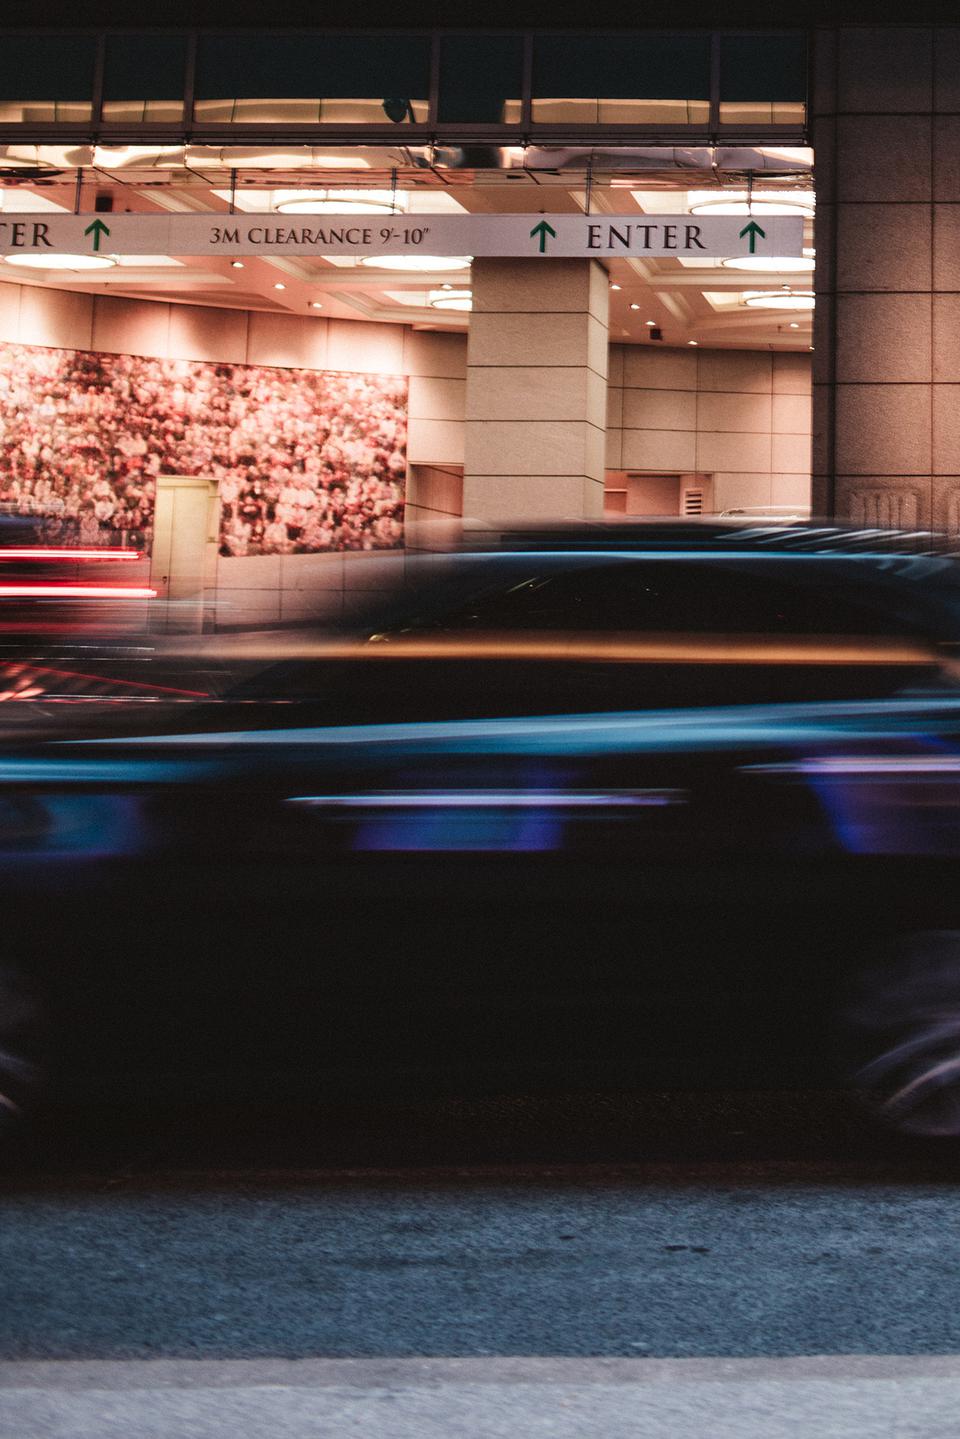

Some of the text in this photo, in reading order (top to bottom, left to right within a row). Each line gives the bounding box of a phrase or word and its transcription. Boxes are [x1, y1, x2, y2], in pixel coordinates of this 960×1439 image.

[209, 227, 240, 244] 3M
[247, 227, 372, 244] CLEARANCE
[586, 224, 709, 249] ENTER
